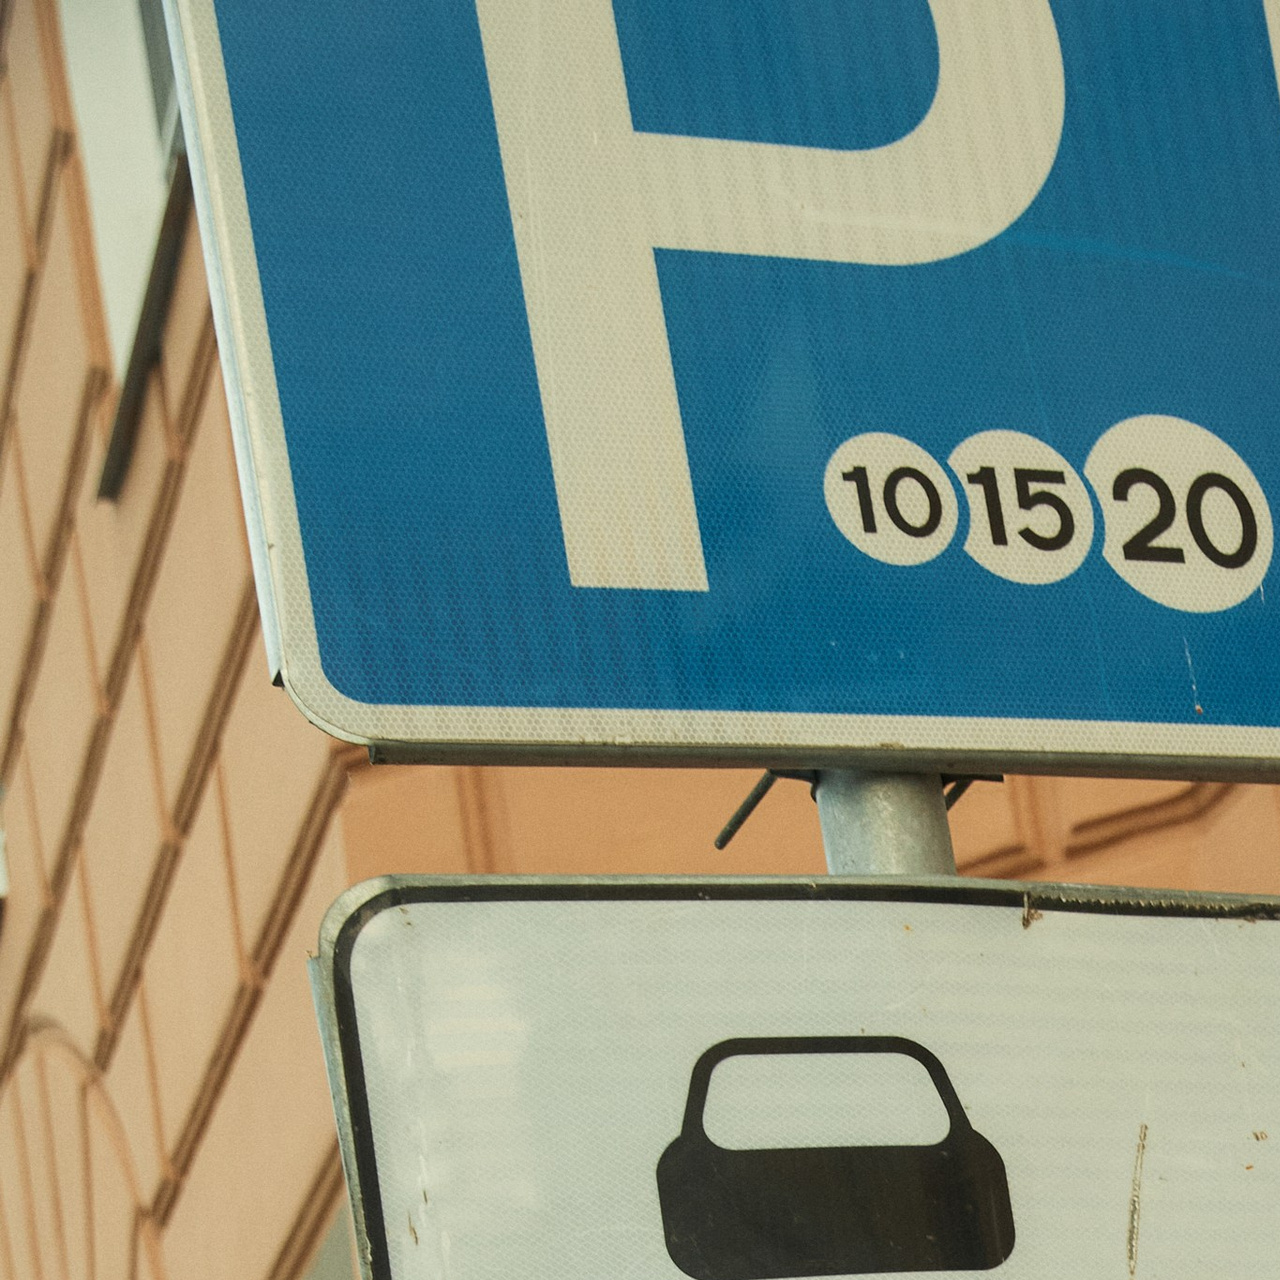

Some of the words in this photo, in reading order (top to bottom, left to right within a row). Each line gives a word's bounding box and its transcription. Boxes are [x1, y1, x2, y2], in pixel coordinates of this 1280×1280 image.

[474, 0, 1066, 593] P
[841, 465, 943, 538] 10
[966, 466, 1075, 551] 15
[1112, 467, 1258, 569] 20
